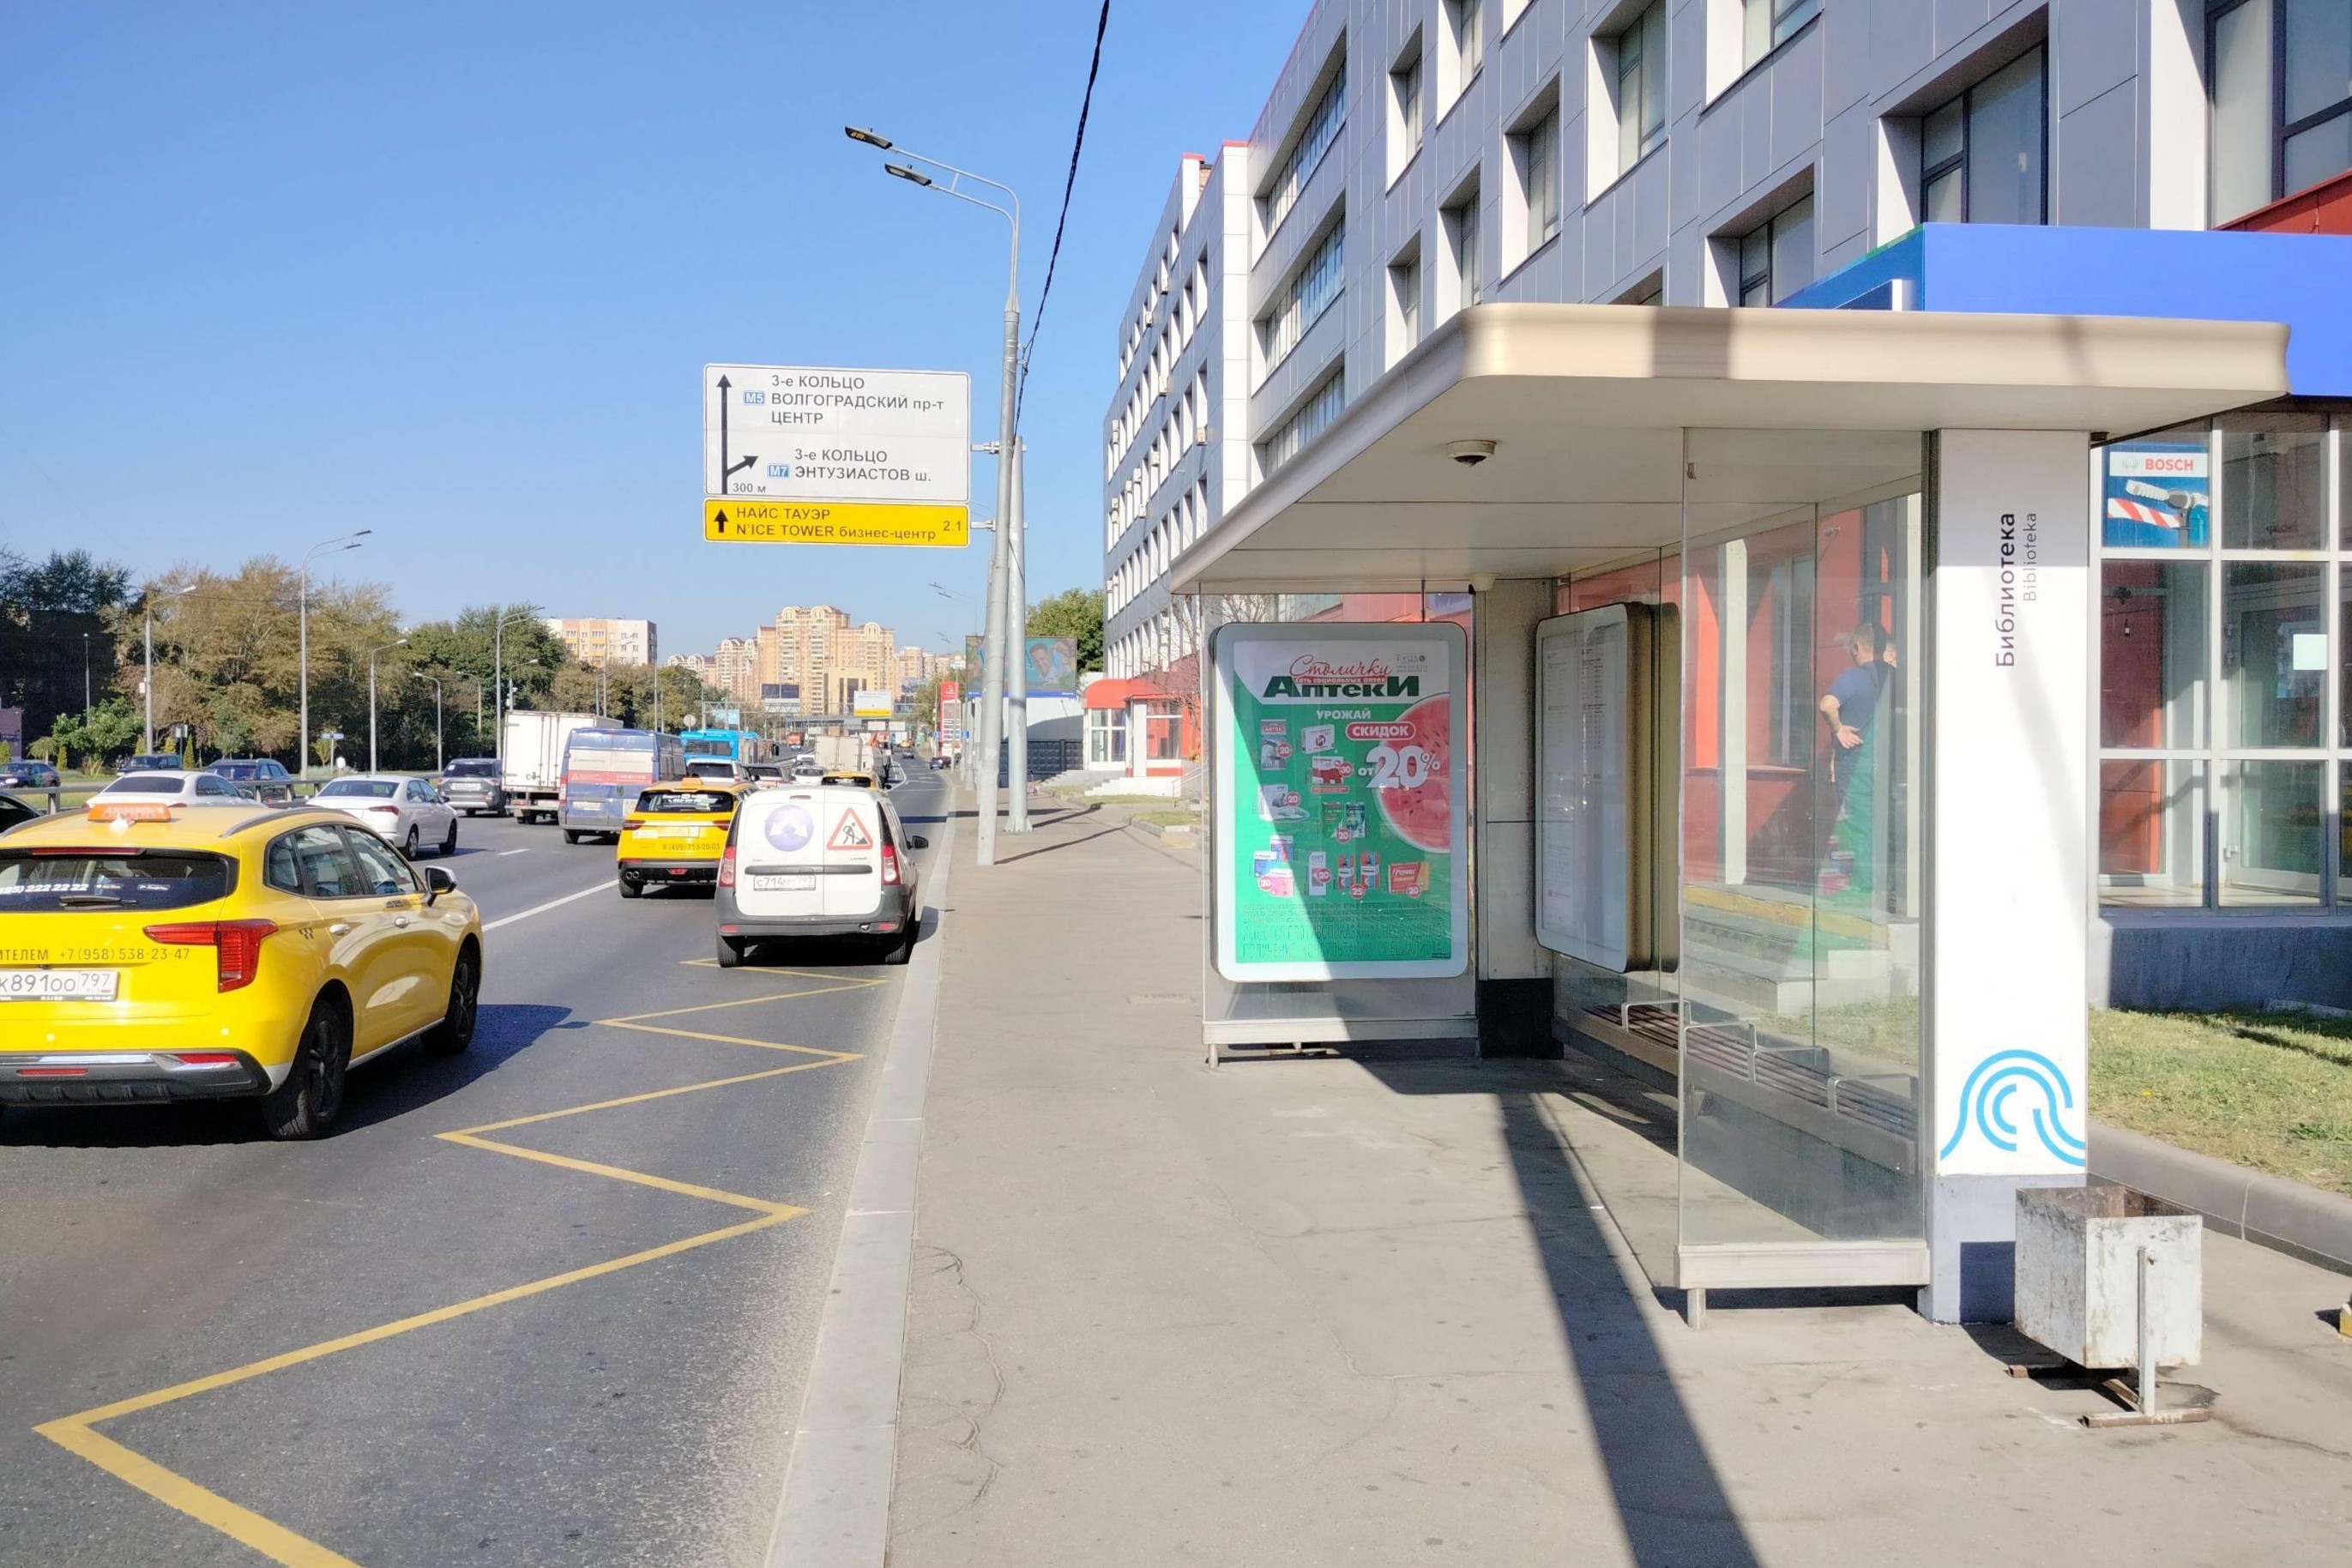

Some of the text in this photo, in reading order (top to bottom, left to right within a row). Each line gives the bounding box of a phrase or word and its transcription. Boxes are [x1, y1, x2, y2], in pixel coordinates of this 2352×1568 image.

[771, 375, 865, 389] 3-е КОЛЬЦО
[771, 393, 944, 411] ВОЛГОГРАДСКИЙ пр-т
[771, 412, 823, 425] ЦЕНТР
[794, 449, 888, 463] 3-е КОЛЬЦО
[2144, 458, 2194, 472] BOSCH
[795, 467, 932, 482] ЭНТУЗИАСТОВ ш.
[733, 483, 754, 493] 300
[736, 505, 830, 521] НАЙС ТАУЭР
[781, 525, 835, 538] TOWER
[943, 521, 962, 532] 2.1
[839, 527, 936, 540] бизнес-центр
[2022, 512, 2037, 602] Biblioteka
[1994, 513, 2015, 667] Библиотека
[1289, 654, 1392, 676] Столички
[1316, 708, 1371, 720] УРОЖАЙ
[1352, 727, 1409, 738] СКИДОК
[1358, 767, 1374, 776] от
[1288, 794, 1298, 803] 20
[1338, 831, 1348, 840] 20
[59, 949, 75, 961] +7
[78, 948, 115, 961] (958)
[119, 948, 190, 961] 538-23-47
